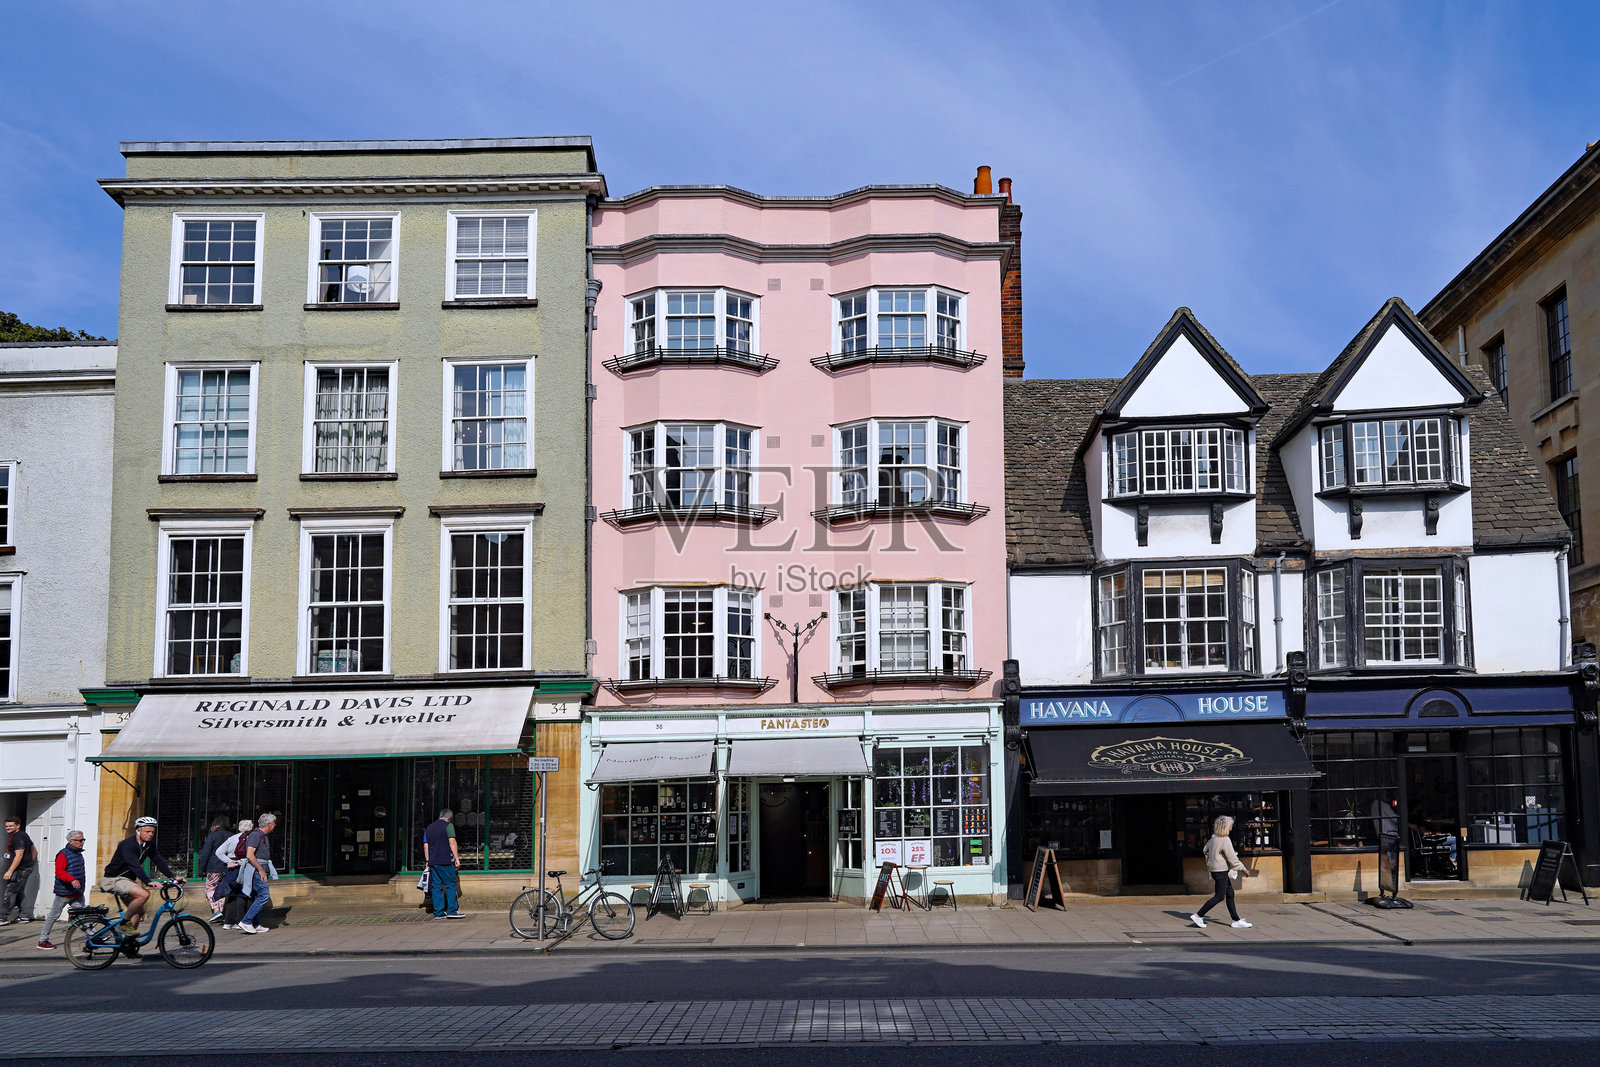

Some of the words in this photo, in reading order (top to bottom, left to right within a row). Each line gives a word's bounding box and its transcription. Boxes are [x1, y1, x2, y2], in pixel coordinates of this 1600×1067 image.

[194, 698, 331, 713] REGINALD
[340, 696, 414, 711] DAVIS
[423, 694, 473, 707] LTD
[551, 702, 567, 714] 34
[1029, 700, 1113, 719] HAVANA
[1198, 695, 1270, 715] HOUSE
[198, 715, 328, 729] Silversmith
[337, 715, 356, 727] &
[364, 712, 457, 726] Jeweller
[760, 718, 830, 730] FANTASTEA
[1107, 741, 1167, 759] HAVANA
[1171, 742, 1223, 756] HOUSE
[911, 853, 925, 863] EF
